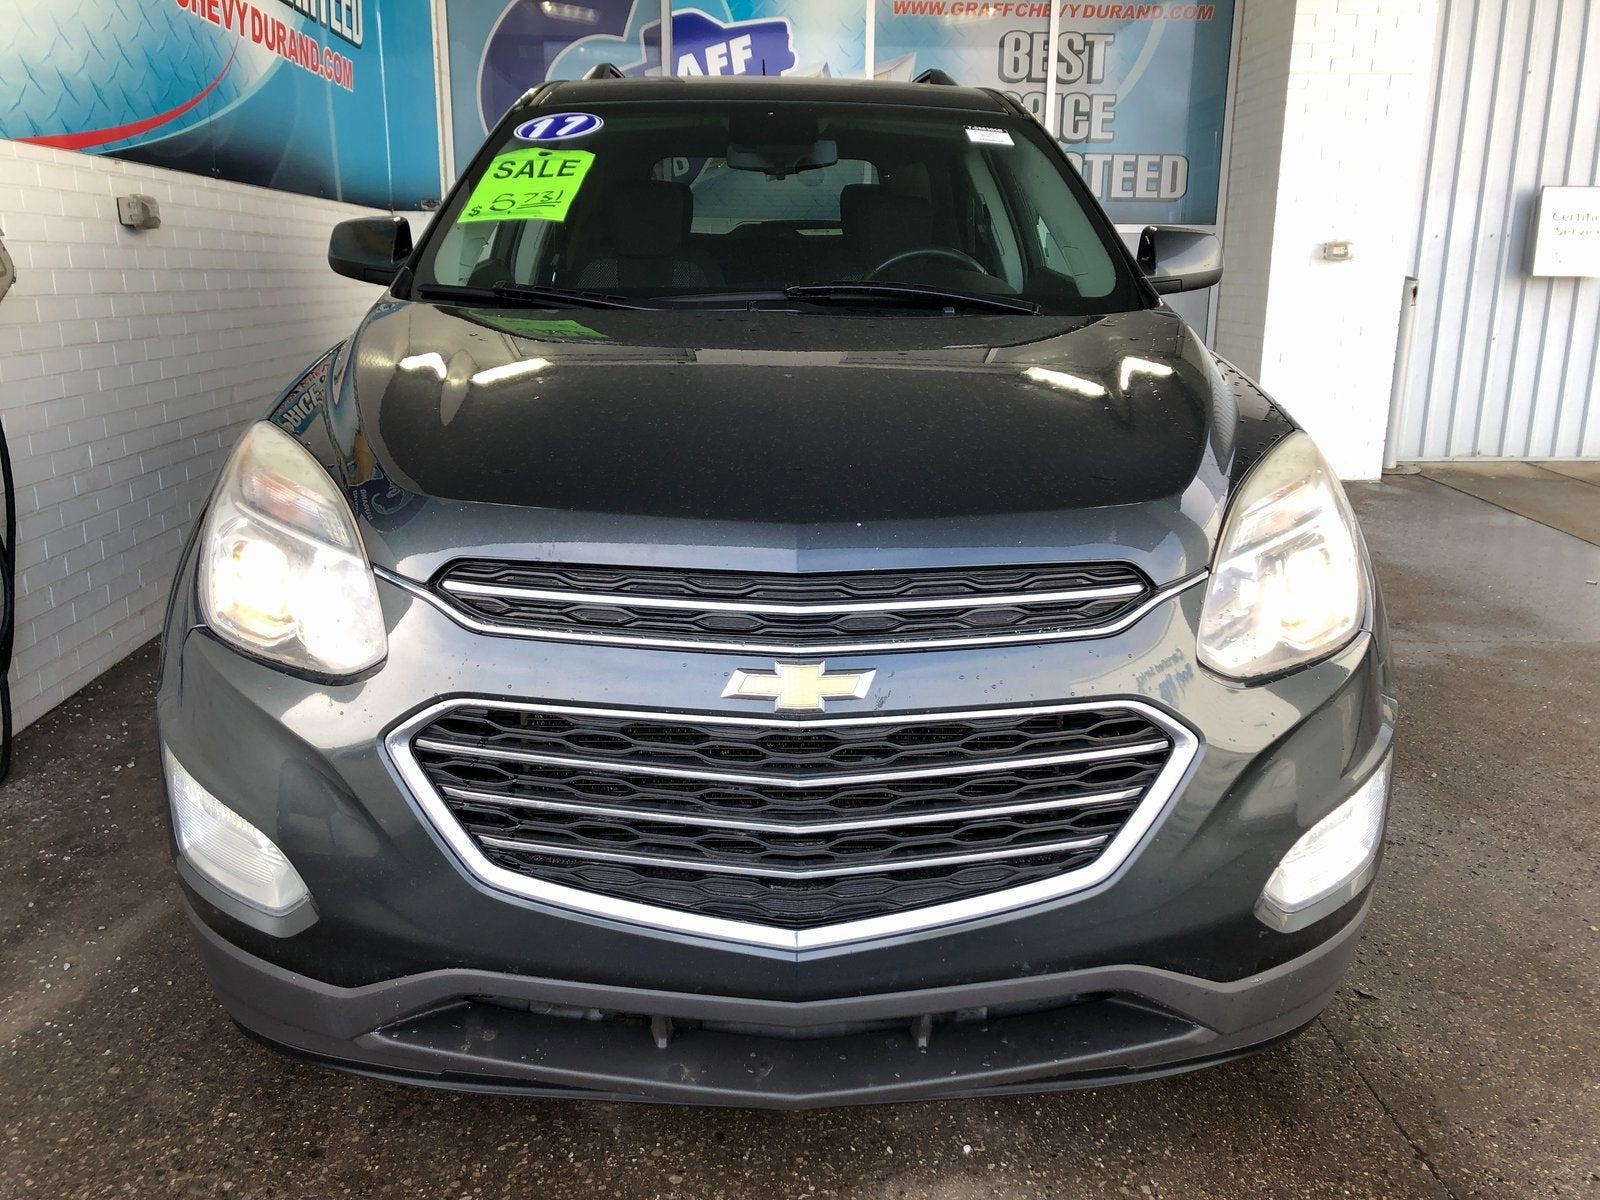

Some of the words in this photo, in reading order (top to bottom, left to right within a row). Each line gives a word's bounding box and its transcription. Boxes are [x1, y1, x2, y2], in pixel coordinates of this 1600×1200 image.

[177, 0, 354, 92] EVYDURAND.COM
[998, 30, 1115, 84] BEST
[528, 115, 588, 138] 17
[1006, 91, 1116, 143] RICE
[493, 160, 580, 178] SALE
